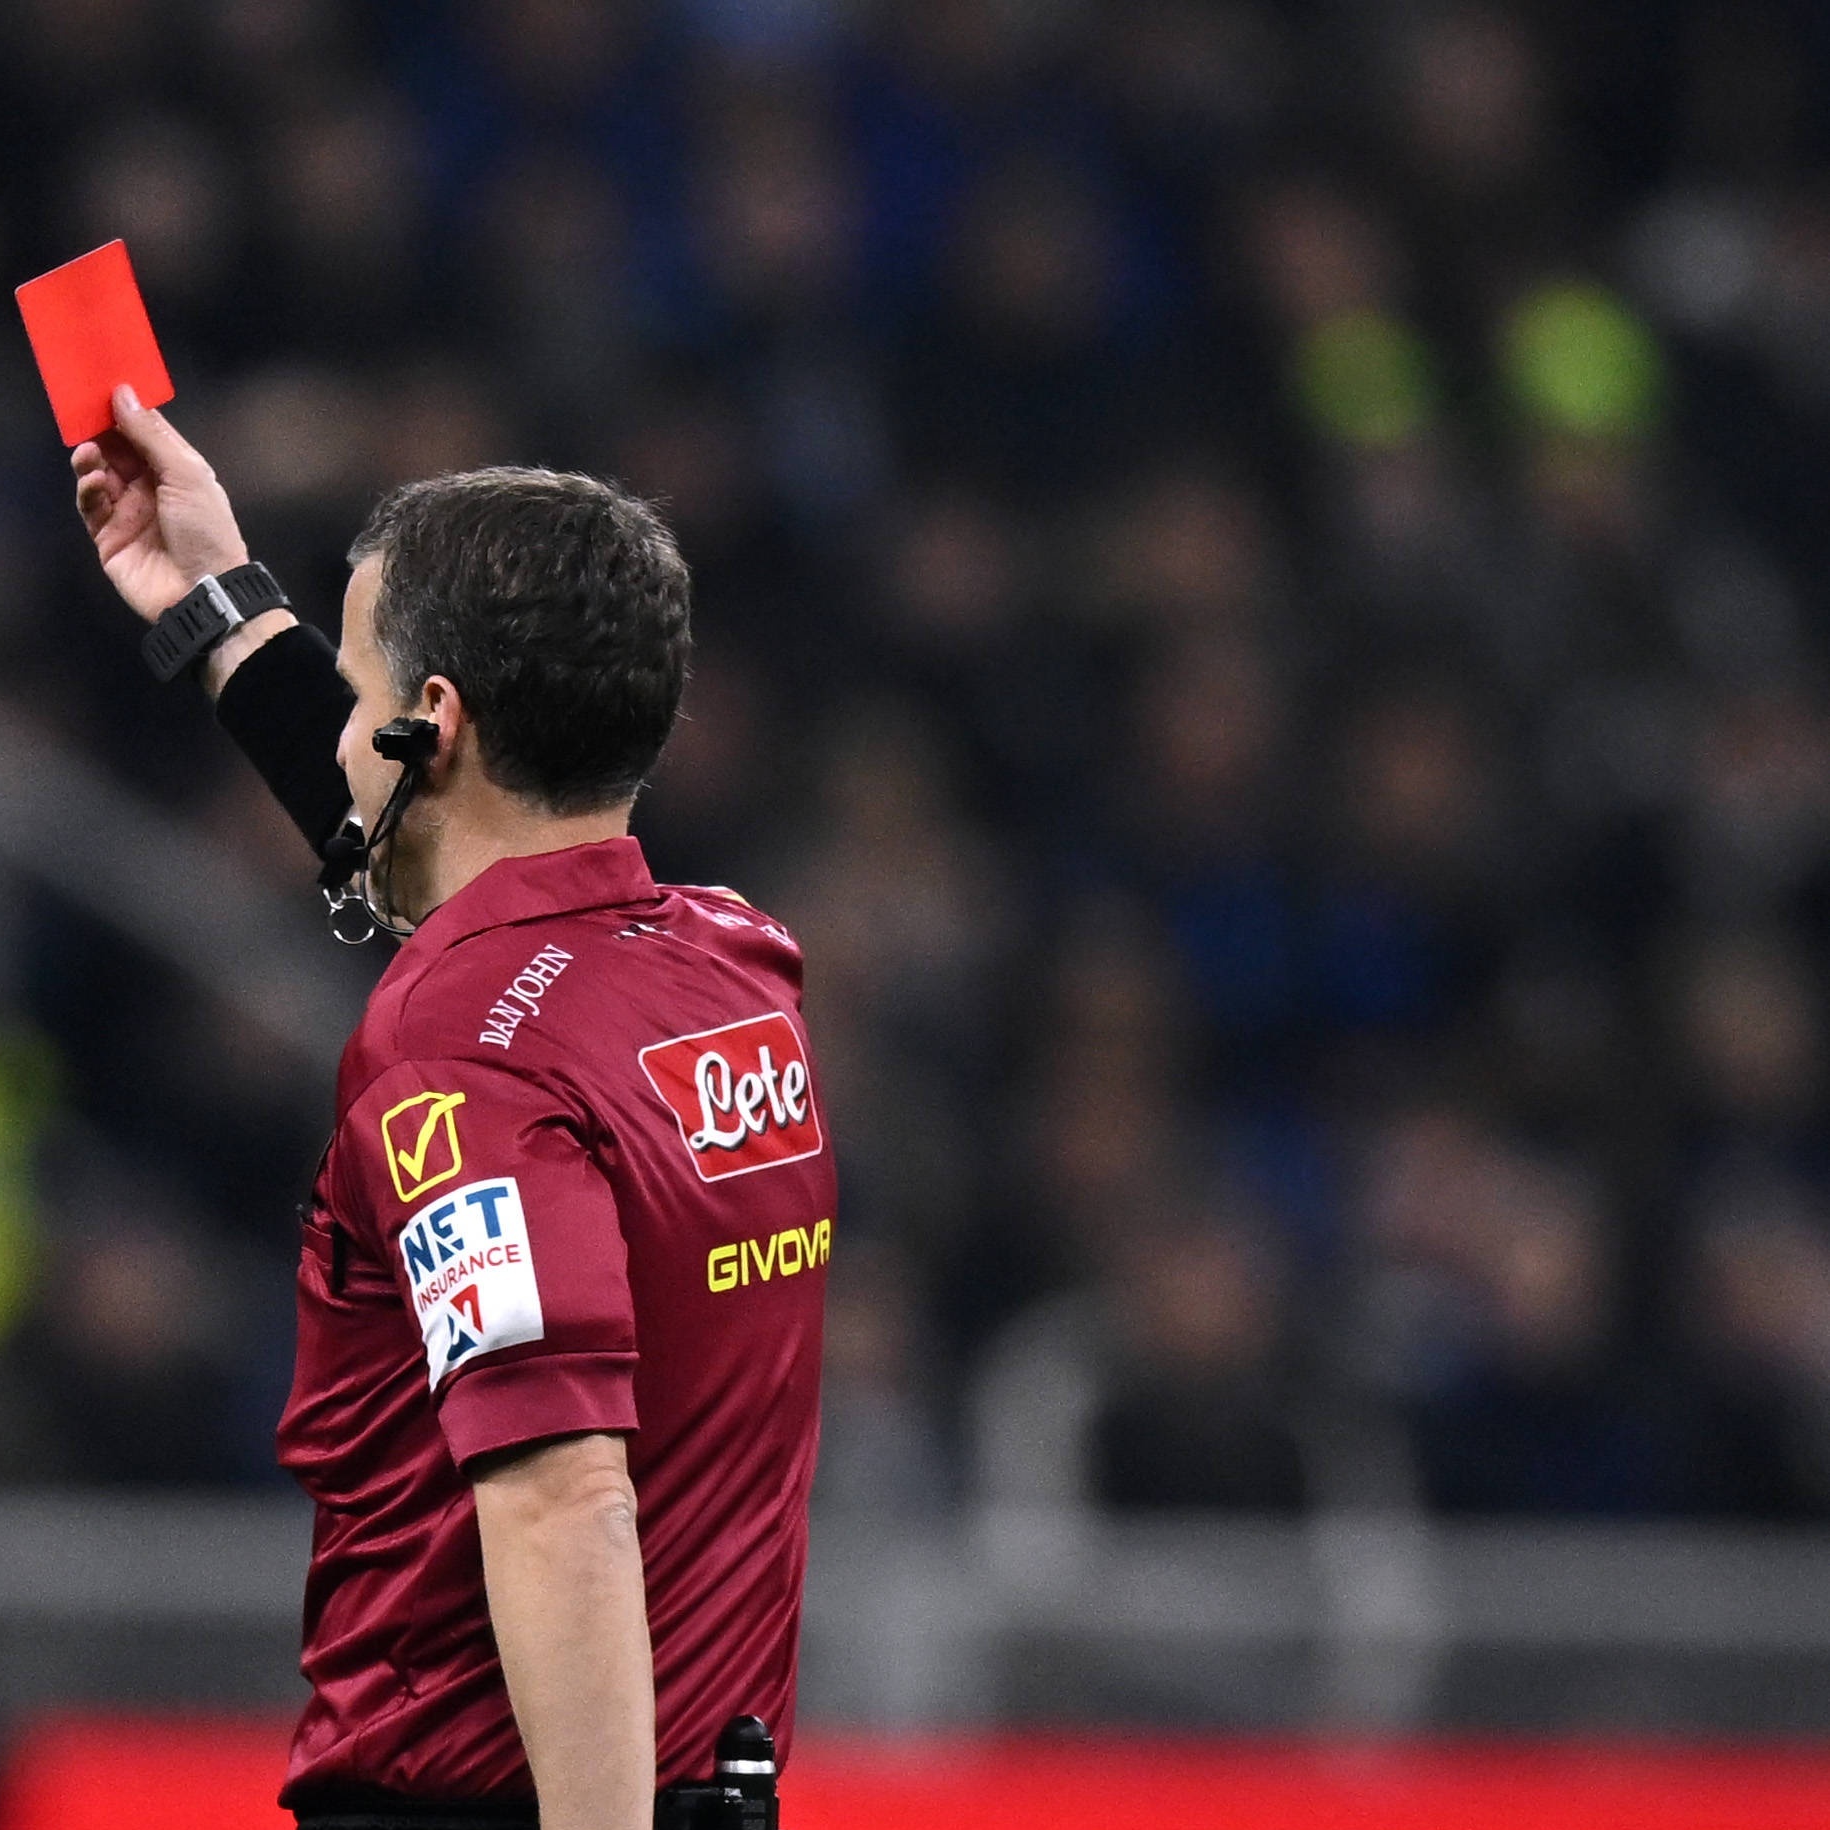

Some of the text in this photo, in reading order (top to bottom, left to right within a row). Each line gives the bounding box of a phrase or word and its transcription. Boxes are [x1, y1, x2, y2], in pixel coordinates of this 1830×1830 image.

[478, 943, 575, 1050] DAN JOHN
[690, 1045, 808, 1151] Lete
[403, 1186, 509, 1286] NET
[416, 1243, 523, 1314] INSURANCE
[706, 1217, 832, 1294] GIVOVA
